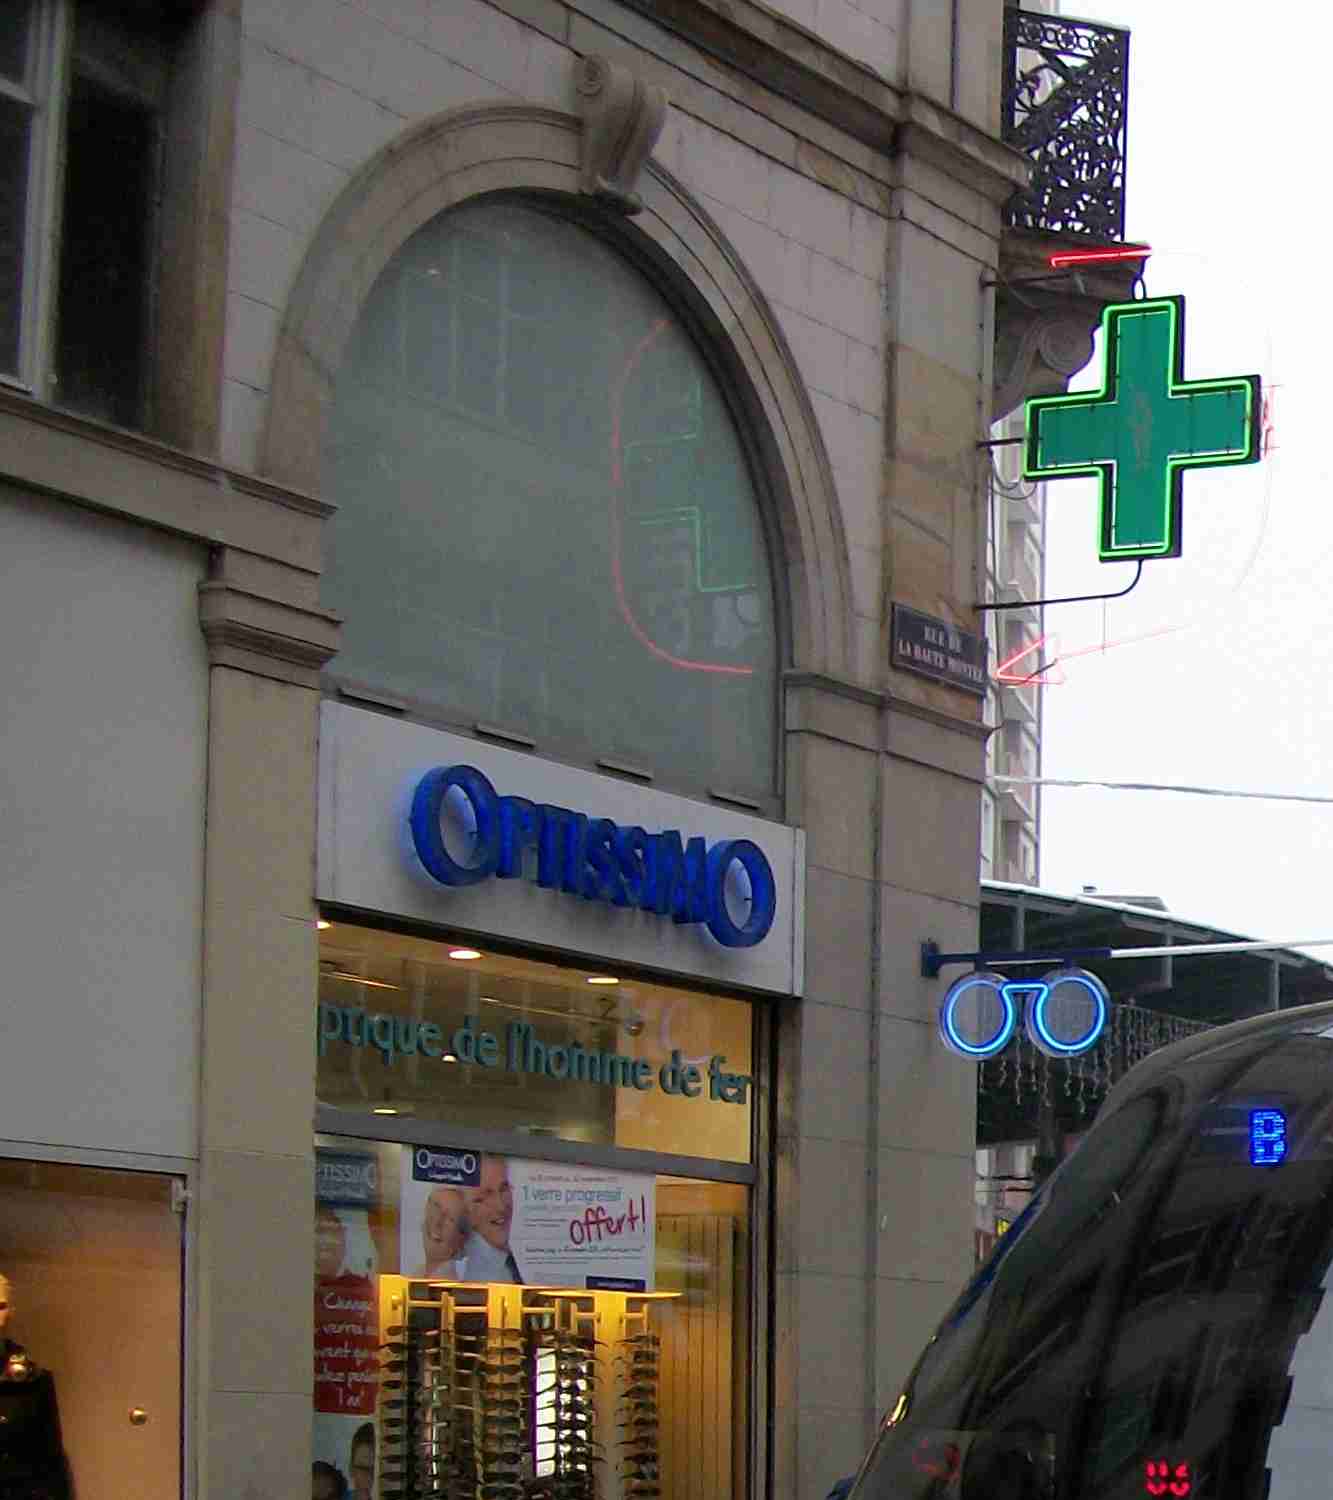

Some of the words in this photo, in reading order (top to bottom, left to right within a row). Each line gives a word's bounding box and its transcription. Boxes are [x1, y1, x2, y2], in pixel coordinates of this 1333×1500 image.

[410, 764, 777, 948] OPTISSIMO
[450, 1013, 498, 1066] de
[508, 1021, 655, 1090] l'homme
[660, 1049, 702, 1098] de
[707, 1054, 752, 1105] fer
[1250, 1109, 1288, 1166] B
[569, 1192, 646, 1246] offert!
